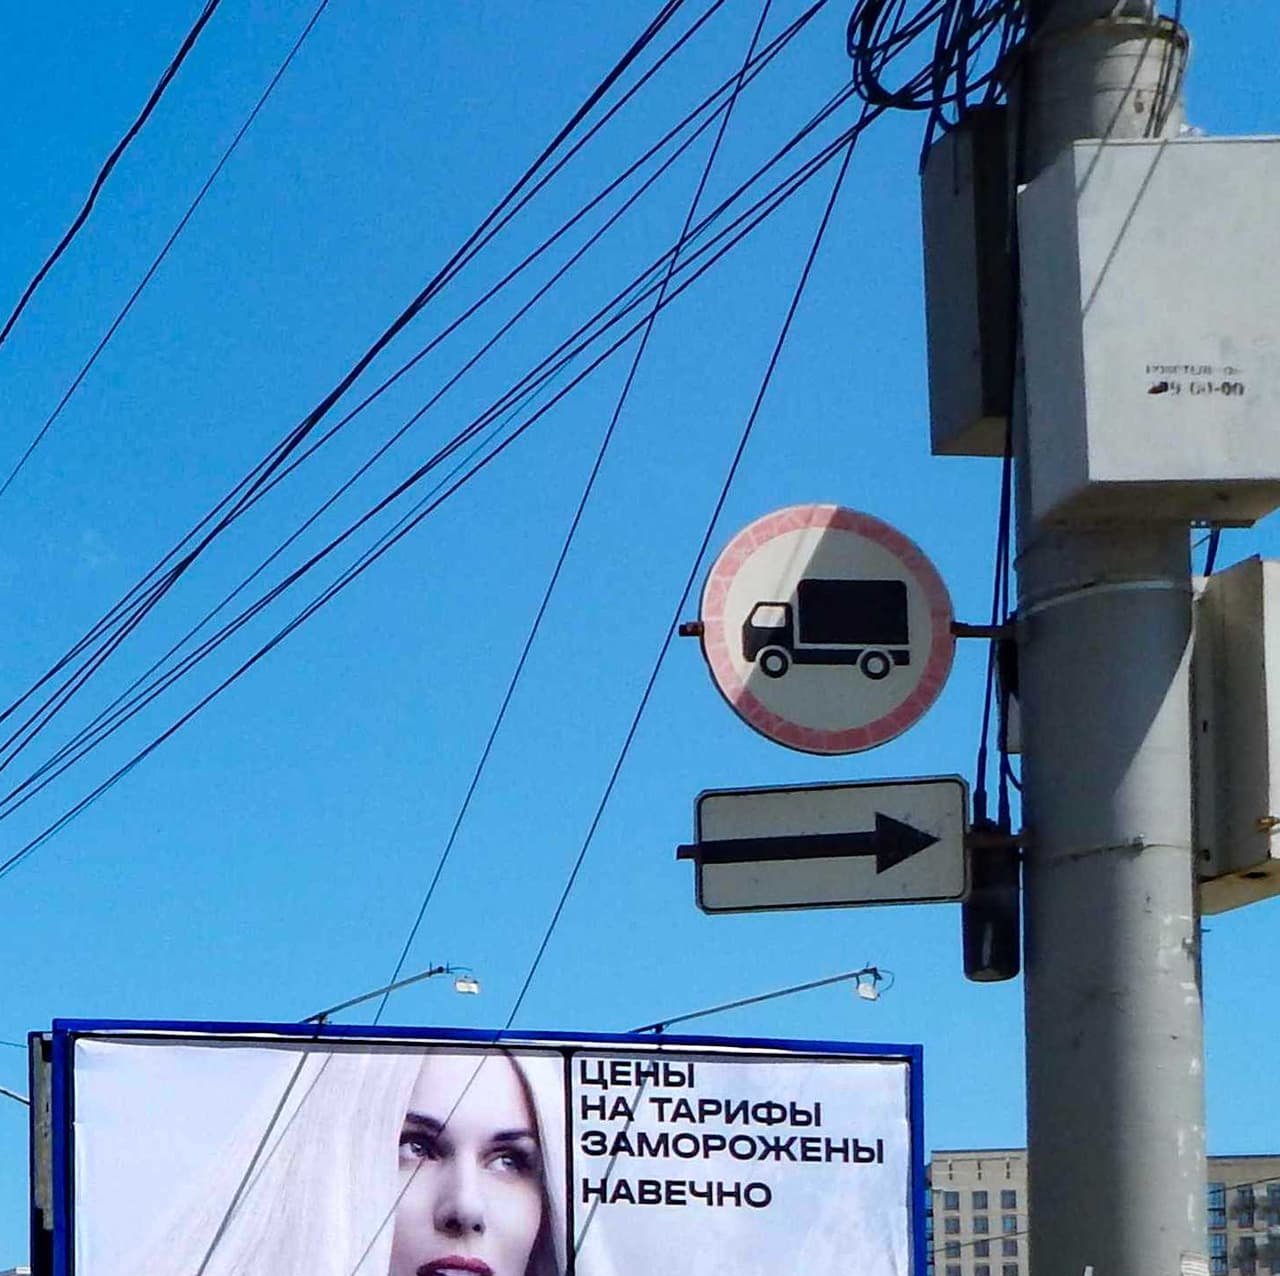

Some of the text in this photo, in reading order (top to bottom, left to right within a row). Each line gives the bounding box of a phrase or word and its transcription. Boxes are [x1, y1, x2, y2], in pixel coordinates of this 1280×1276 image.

[580, 1059, 694, 1090] ЦЕНЫ
[580, 1095, 822, 1127] НА ТАРИФЫ
[580, 1130, 884, 1164] ЗАМОРОЖЕНЫ
[581, 1177, 772, 1208] НАВЕЧНО
